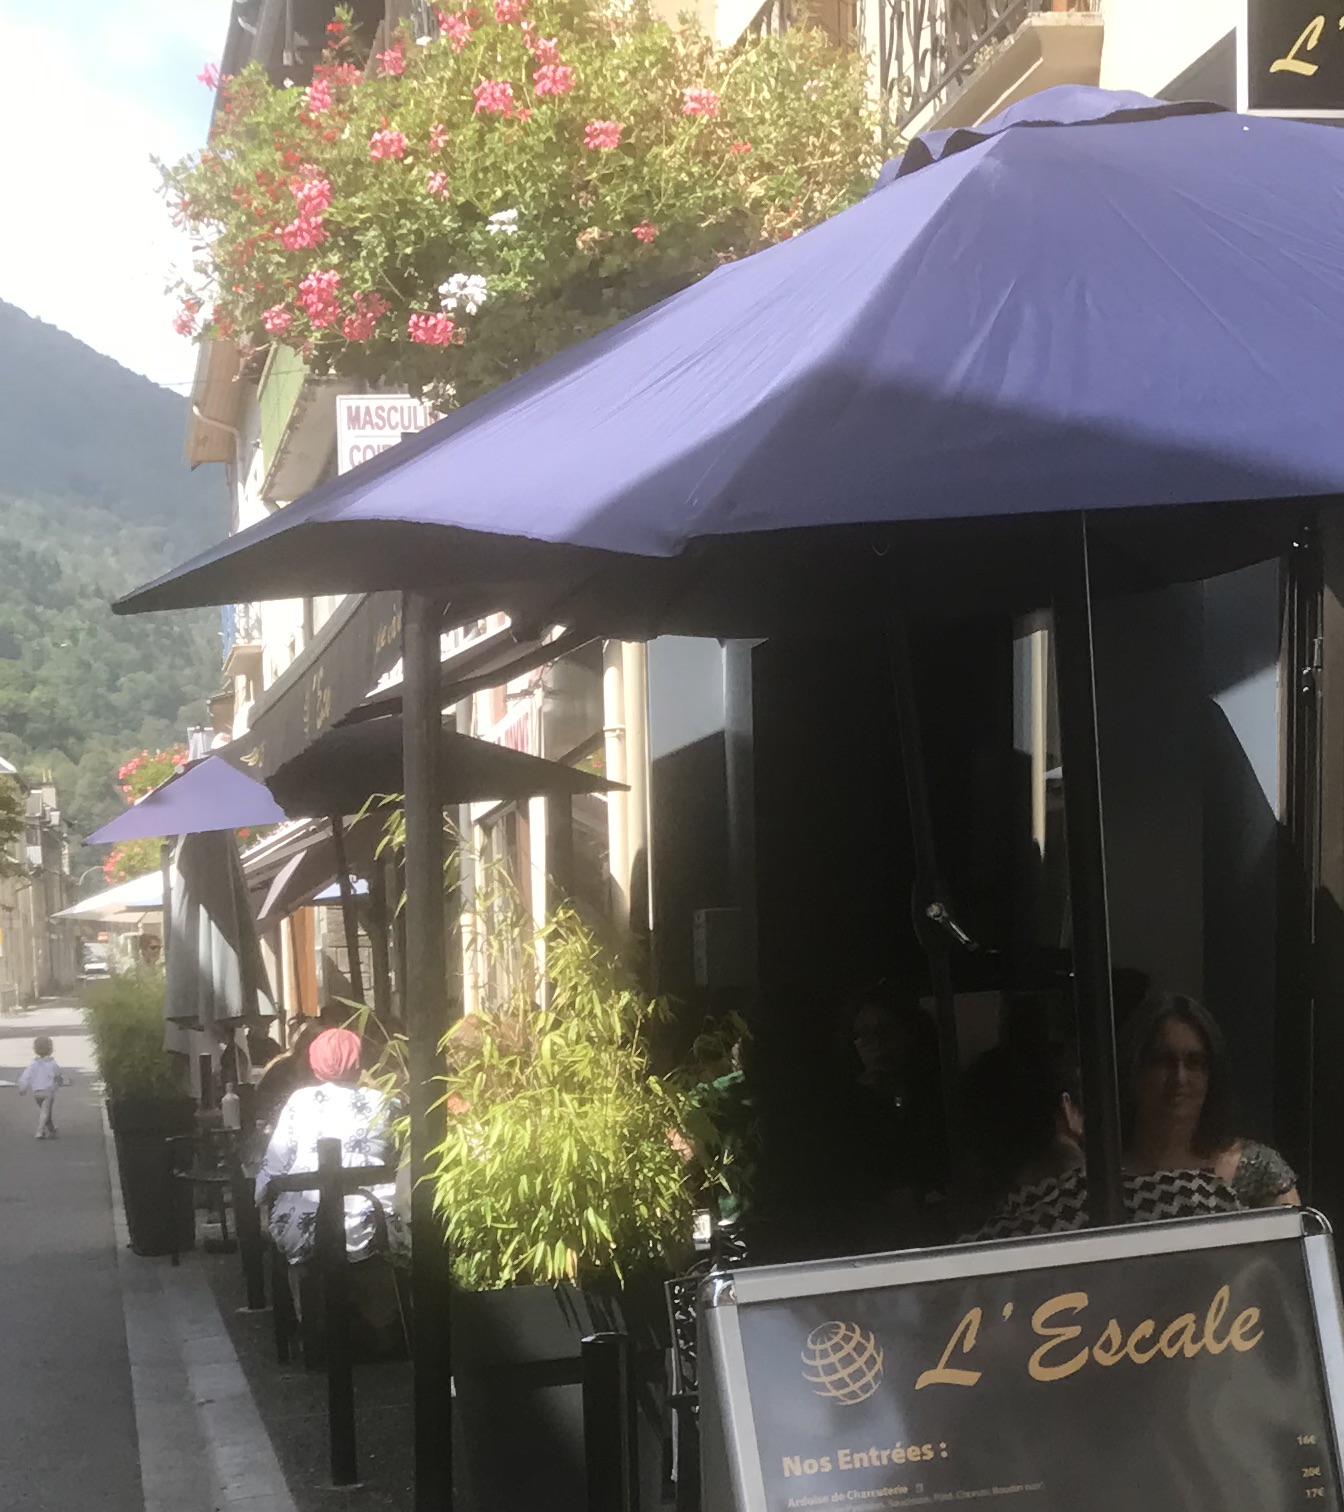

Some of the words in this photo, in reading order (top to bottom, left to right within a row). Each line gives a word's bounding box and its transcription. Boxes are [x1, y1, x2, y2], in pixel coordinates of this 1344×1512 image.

[915, 1284, 1265, 1391] L'Escale
[782, 1453, 832, 1476] Nos
[837, 1442, 935, 1469] Entrées
